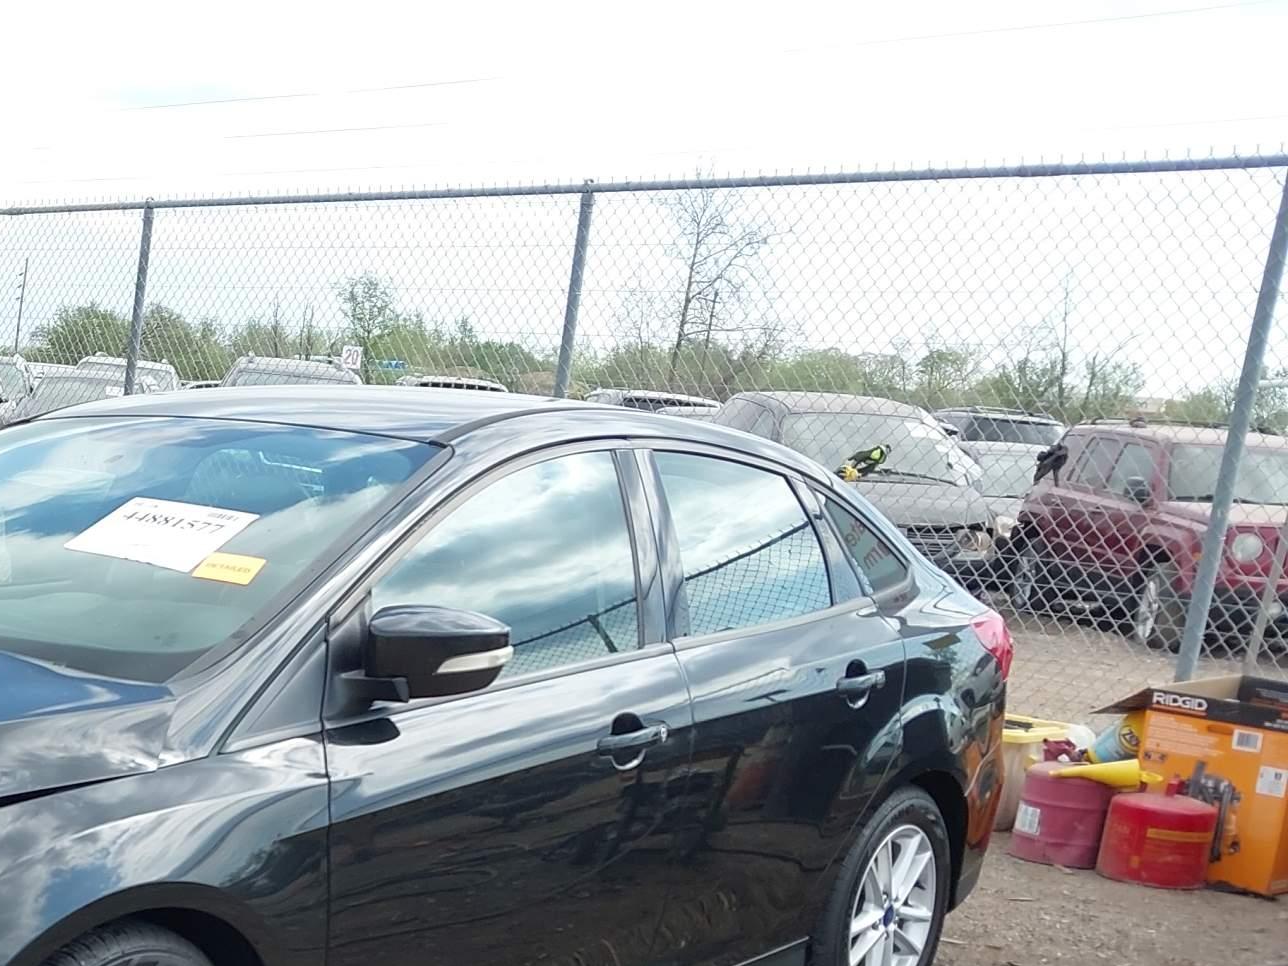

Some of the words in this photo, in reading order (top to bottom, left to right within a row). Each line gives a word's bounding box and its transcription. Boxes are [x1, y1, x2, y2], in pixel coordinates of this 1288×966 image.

[344, 348, 360, 366] 20
[123, 510, 225, 534] 44881577
[1152, 692, 1208, 711] RIDGID
